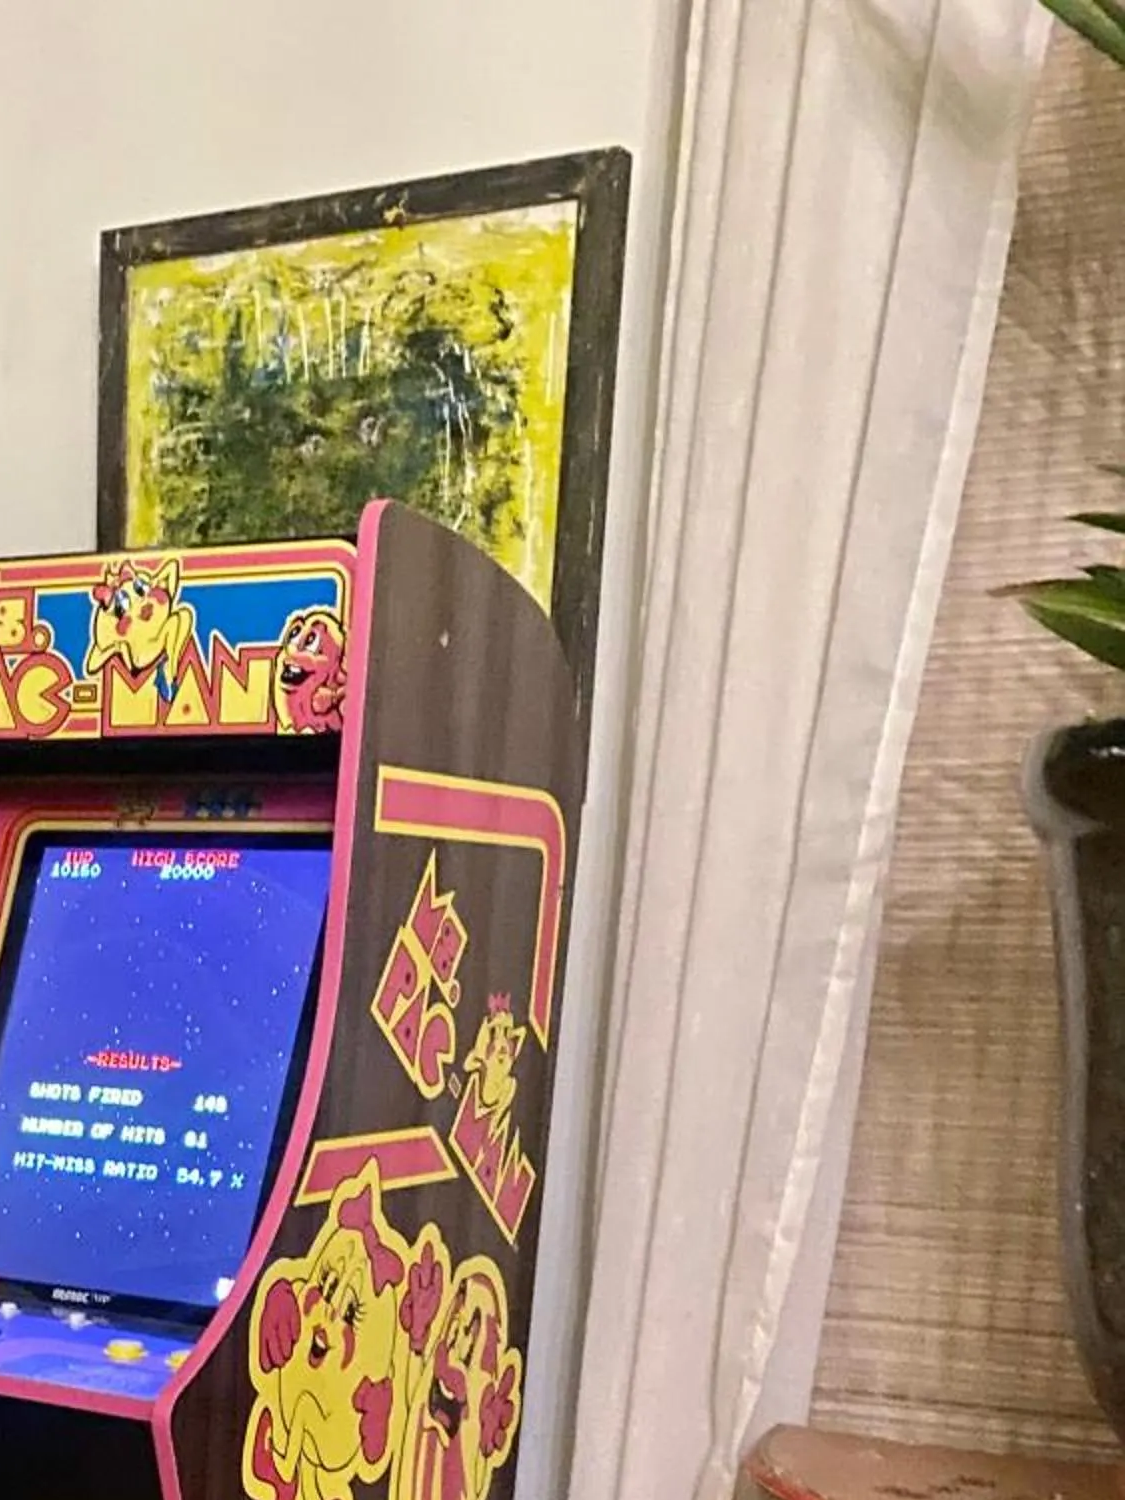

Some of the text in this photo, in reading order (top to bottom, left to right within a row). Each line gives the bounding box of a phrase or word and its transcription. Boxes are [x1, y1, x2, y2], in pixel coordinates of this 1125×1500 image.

[132, 850, 240, 868] HIGH SCORE
[30, 1081, 81, 1101] SHOTS
[88, 1085, 143, 1107] FIRED
[21, 1116, 84, 1137] NUMBER
[90, 1122, 115, 1140] OF
[120, 1125, 166, 1146] HITS
[103, 1159, 158, 1181] RATIO
